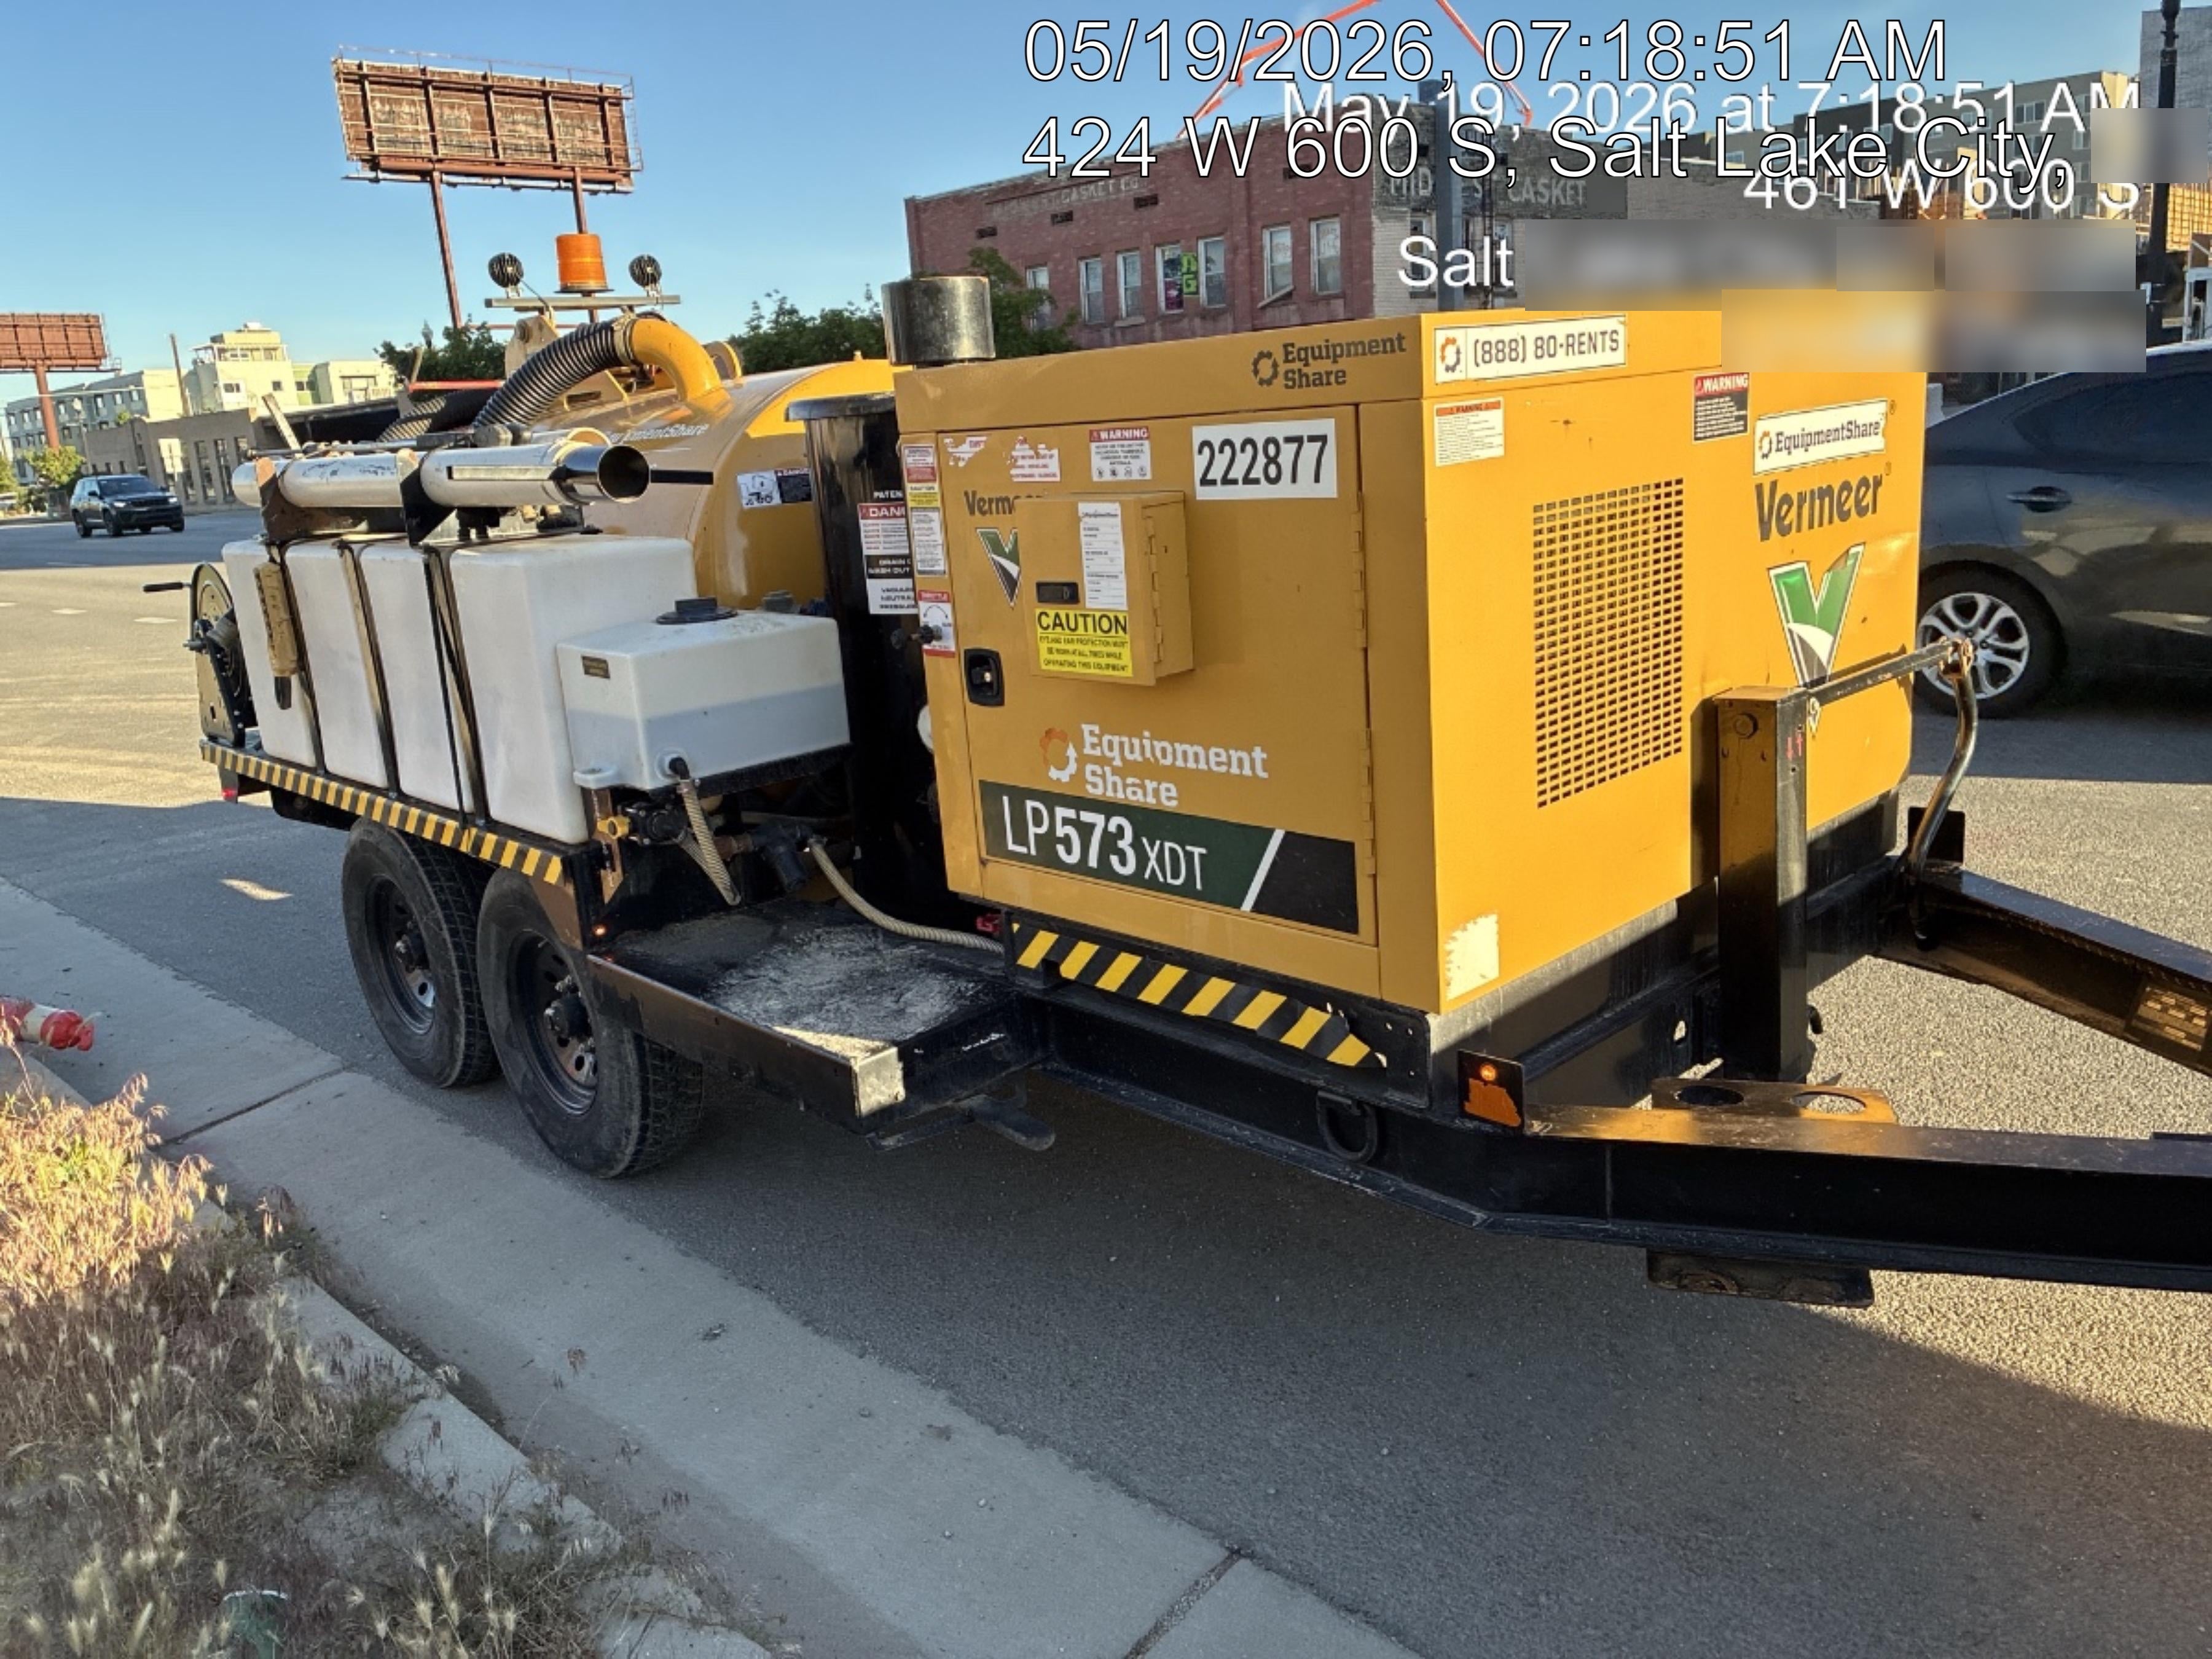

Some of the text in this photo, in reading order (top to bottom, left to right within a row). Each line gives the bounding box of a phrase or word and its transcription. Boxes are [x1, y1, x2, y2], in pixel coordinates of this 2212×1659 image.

[1283, 332, 1406, 367] Equipment
[1474, 335, 1526, 367] (888)
[1284, 369, 1347, 389] Share
[1703, 374, 1748, 394] WARNING
[1100, 428, 1148, 440] WARNING
[1775, 419, 1881, 456] EquipmentShare
[1198, 434, 1328, 487] 222877
[1755, 474, 1883, 542] Vermeer
[1037, 611, 1128, 634] CAUTION
[1085, 764, 1179, 807] Share
